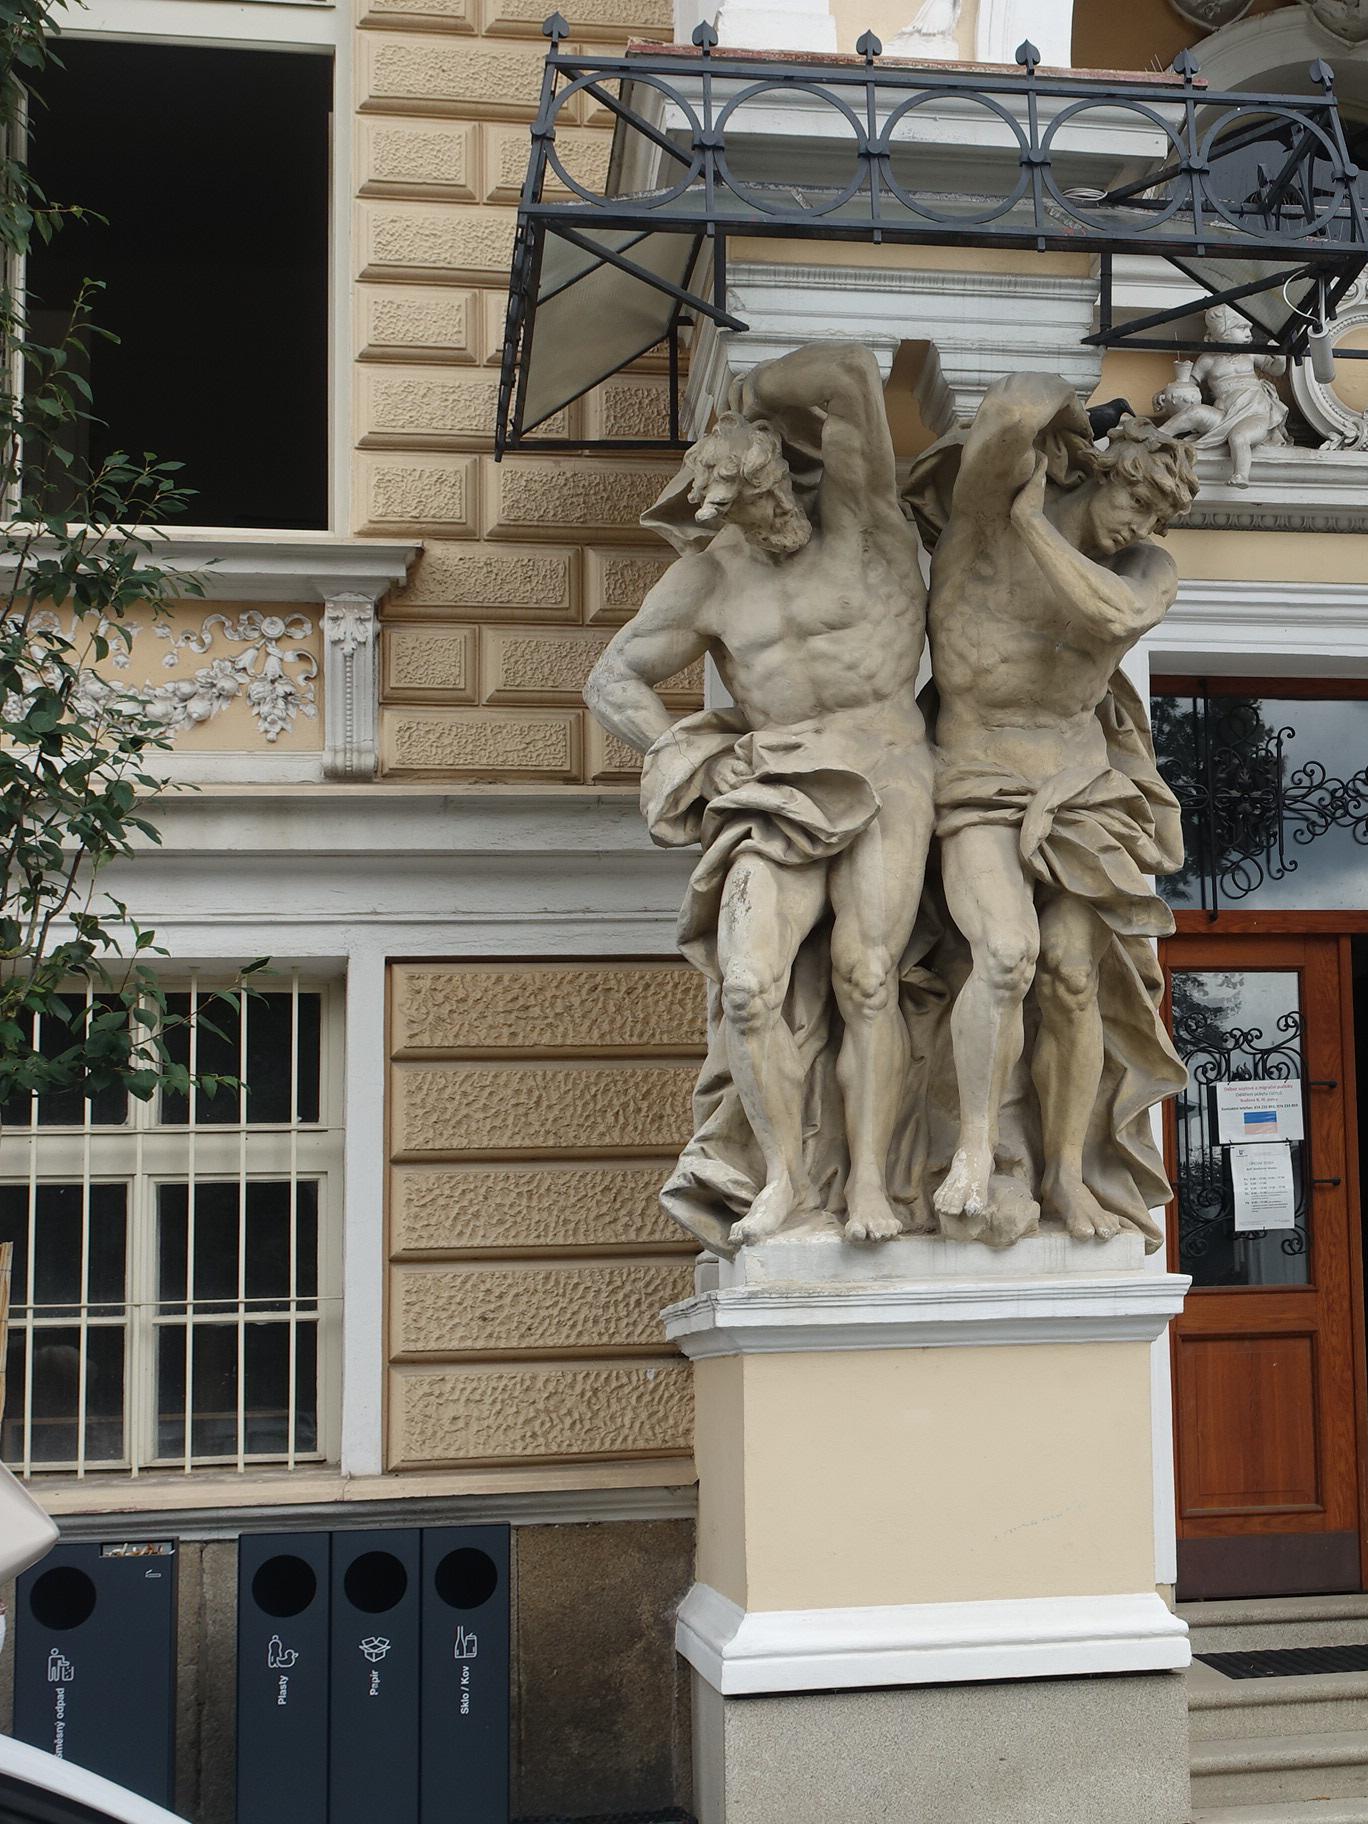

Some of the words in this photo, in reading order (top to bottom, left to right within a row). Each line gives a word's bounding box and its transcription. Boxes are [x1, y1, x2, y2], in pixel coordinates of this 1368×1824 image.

[369, 1669, 380, 1696] Papír
[460, 1665, 470, 1685] Kov
[55, 1687, 66, 1719] odpad
[277, 1675, 289, 1705] Plasty
[460, 1693, 470, 1715] Sklo
